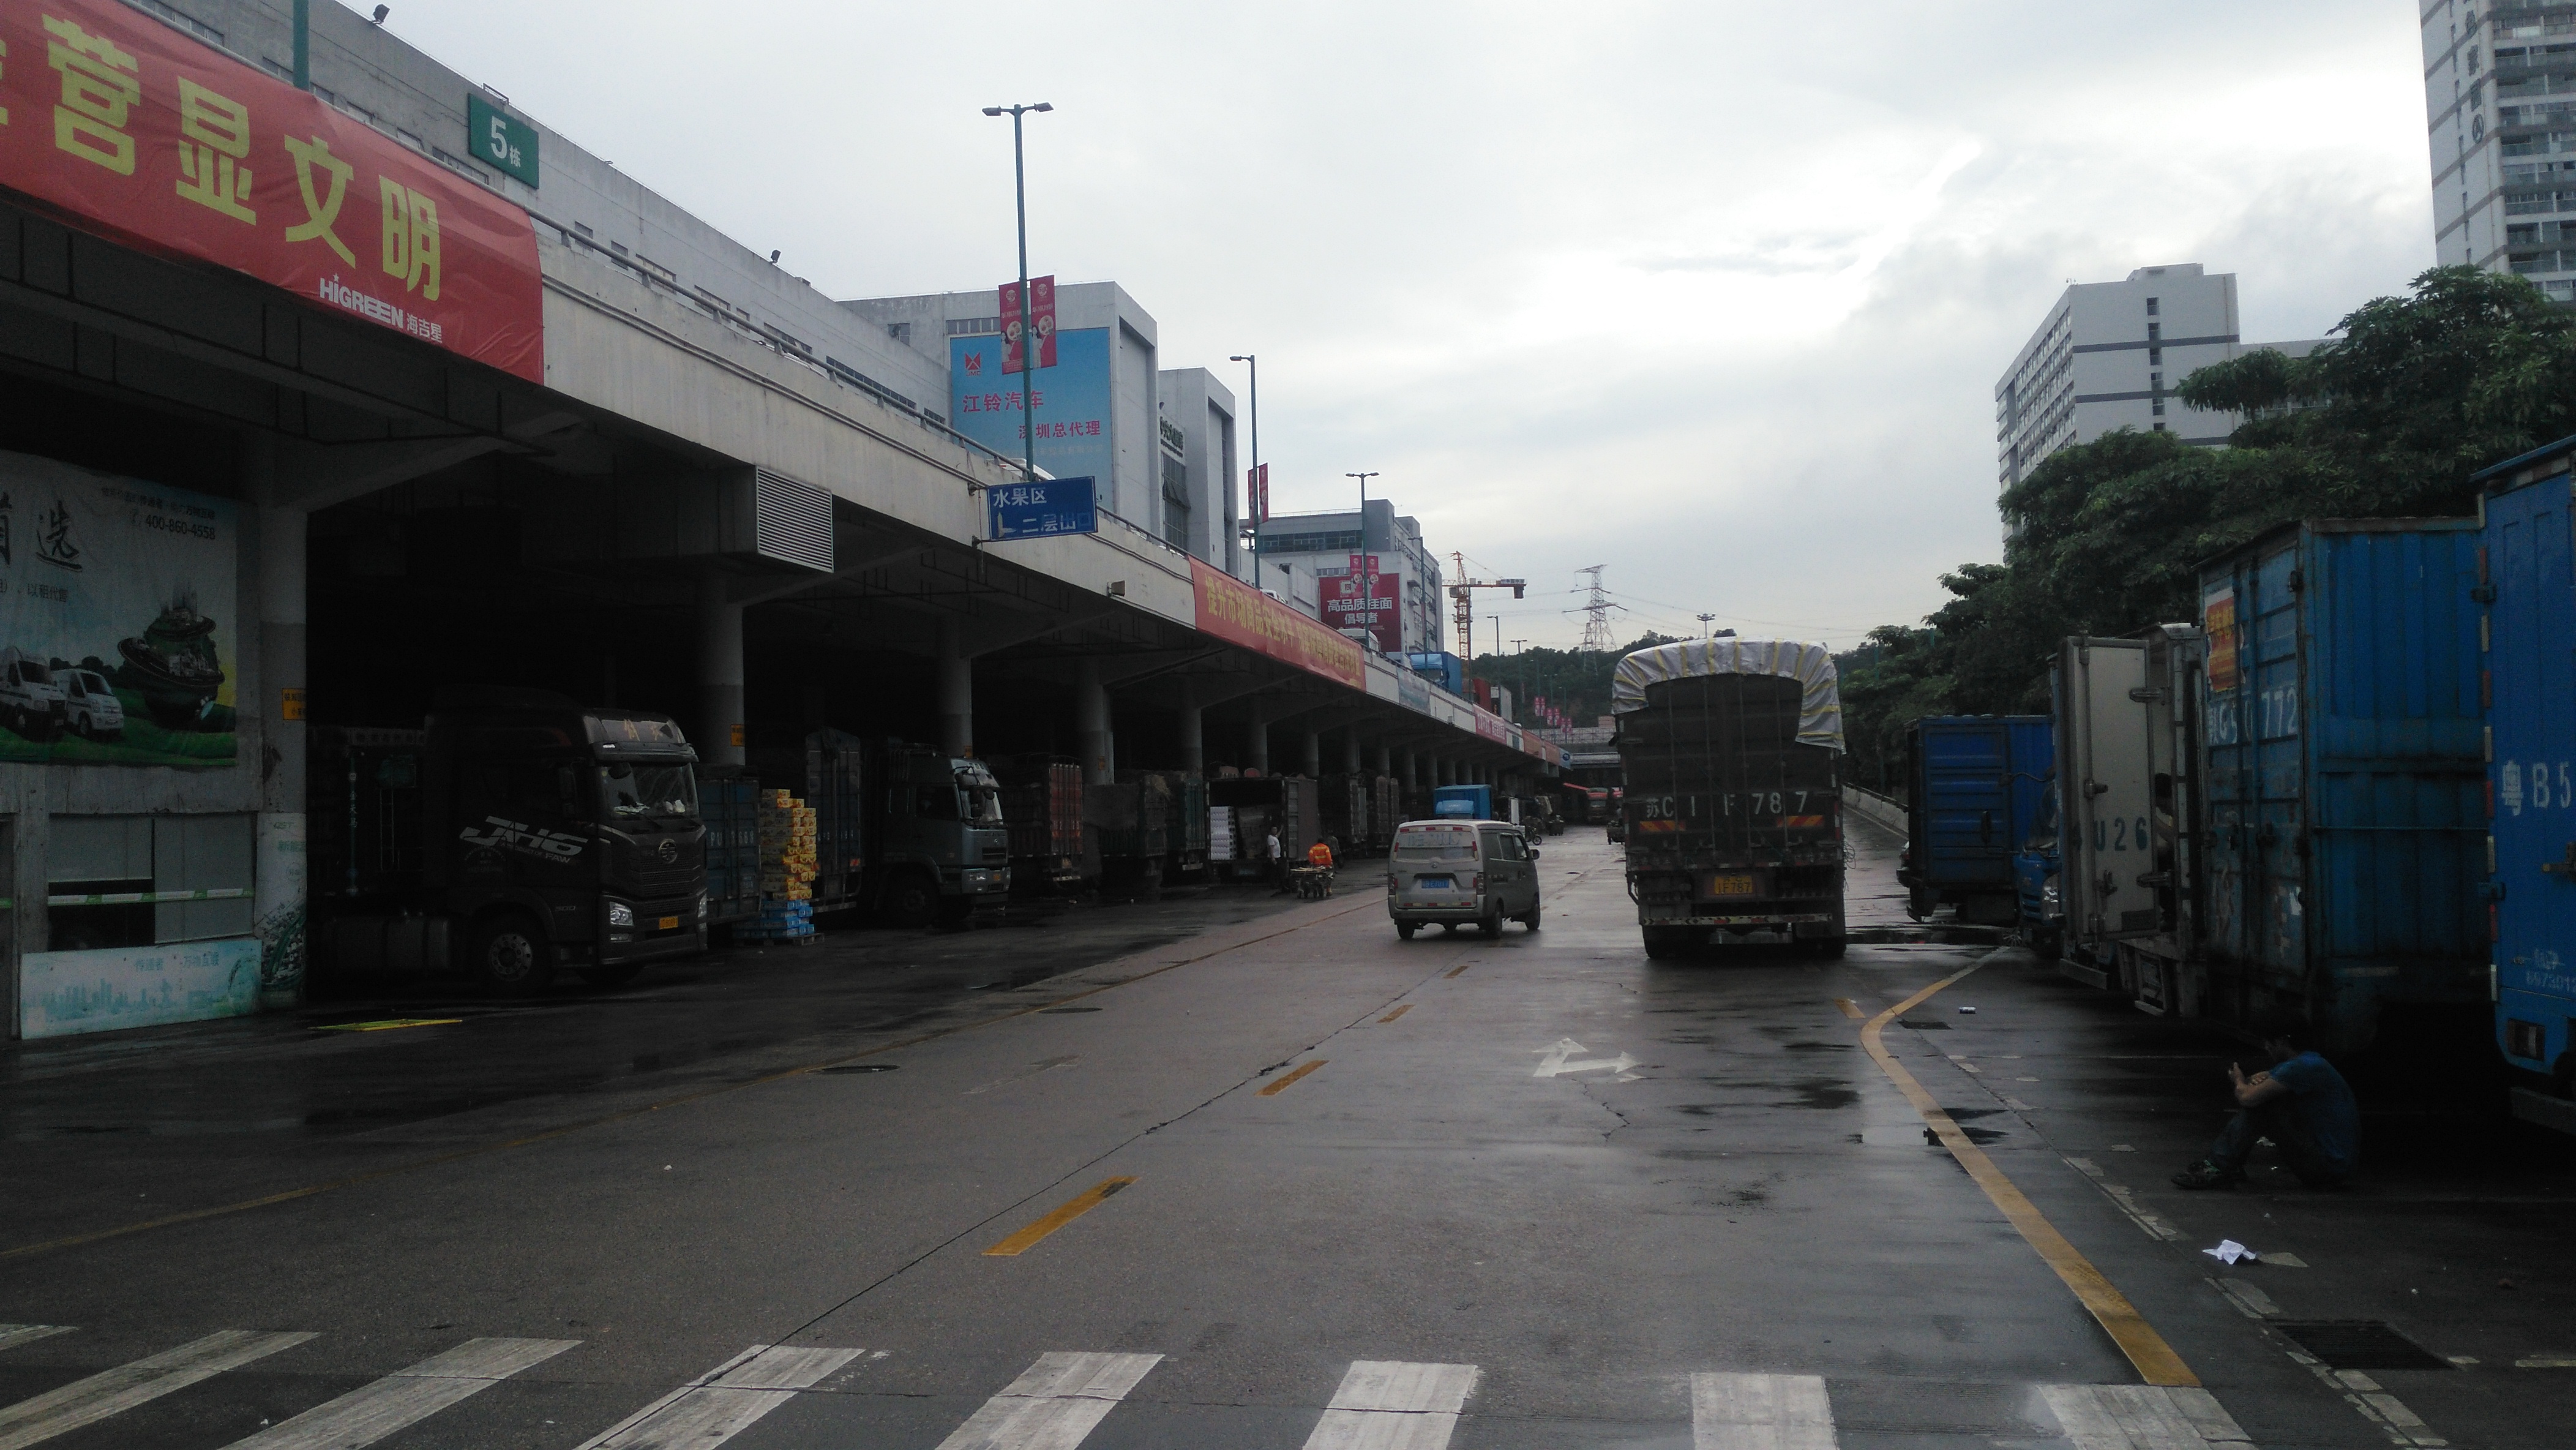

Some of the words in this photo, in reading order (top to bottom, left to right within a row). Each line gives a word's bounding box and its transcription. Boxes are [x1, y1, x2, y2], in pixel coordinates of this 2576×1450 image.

[490, 118, 522, 168] 5栋
[0, 13, 441, 301] 营显文明
[406, 313, 443, 344] 海吉星
[963, 390, 1044, 413] 江铃汽车
[992, 487, 1047, 508] 水果区
[1022, 512, 1091, 533] 二层出口
[1327, 597, 1393, 613] 高品质挂面
[1344, 612, 1379, 625] 倡导者
[544, 852, 571, 864] FAW
